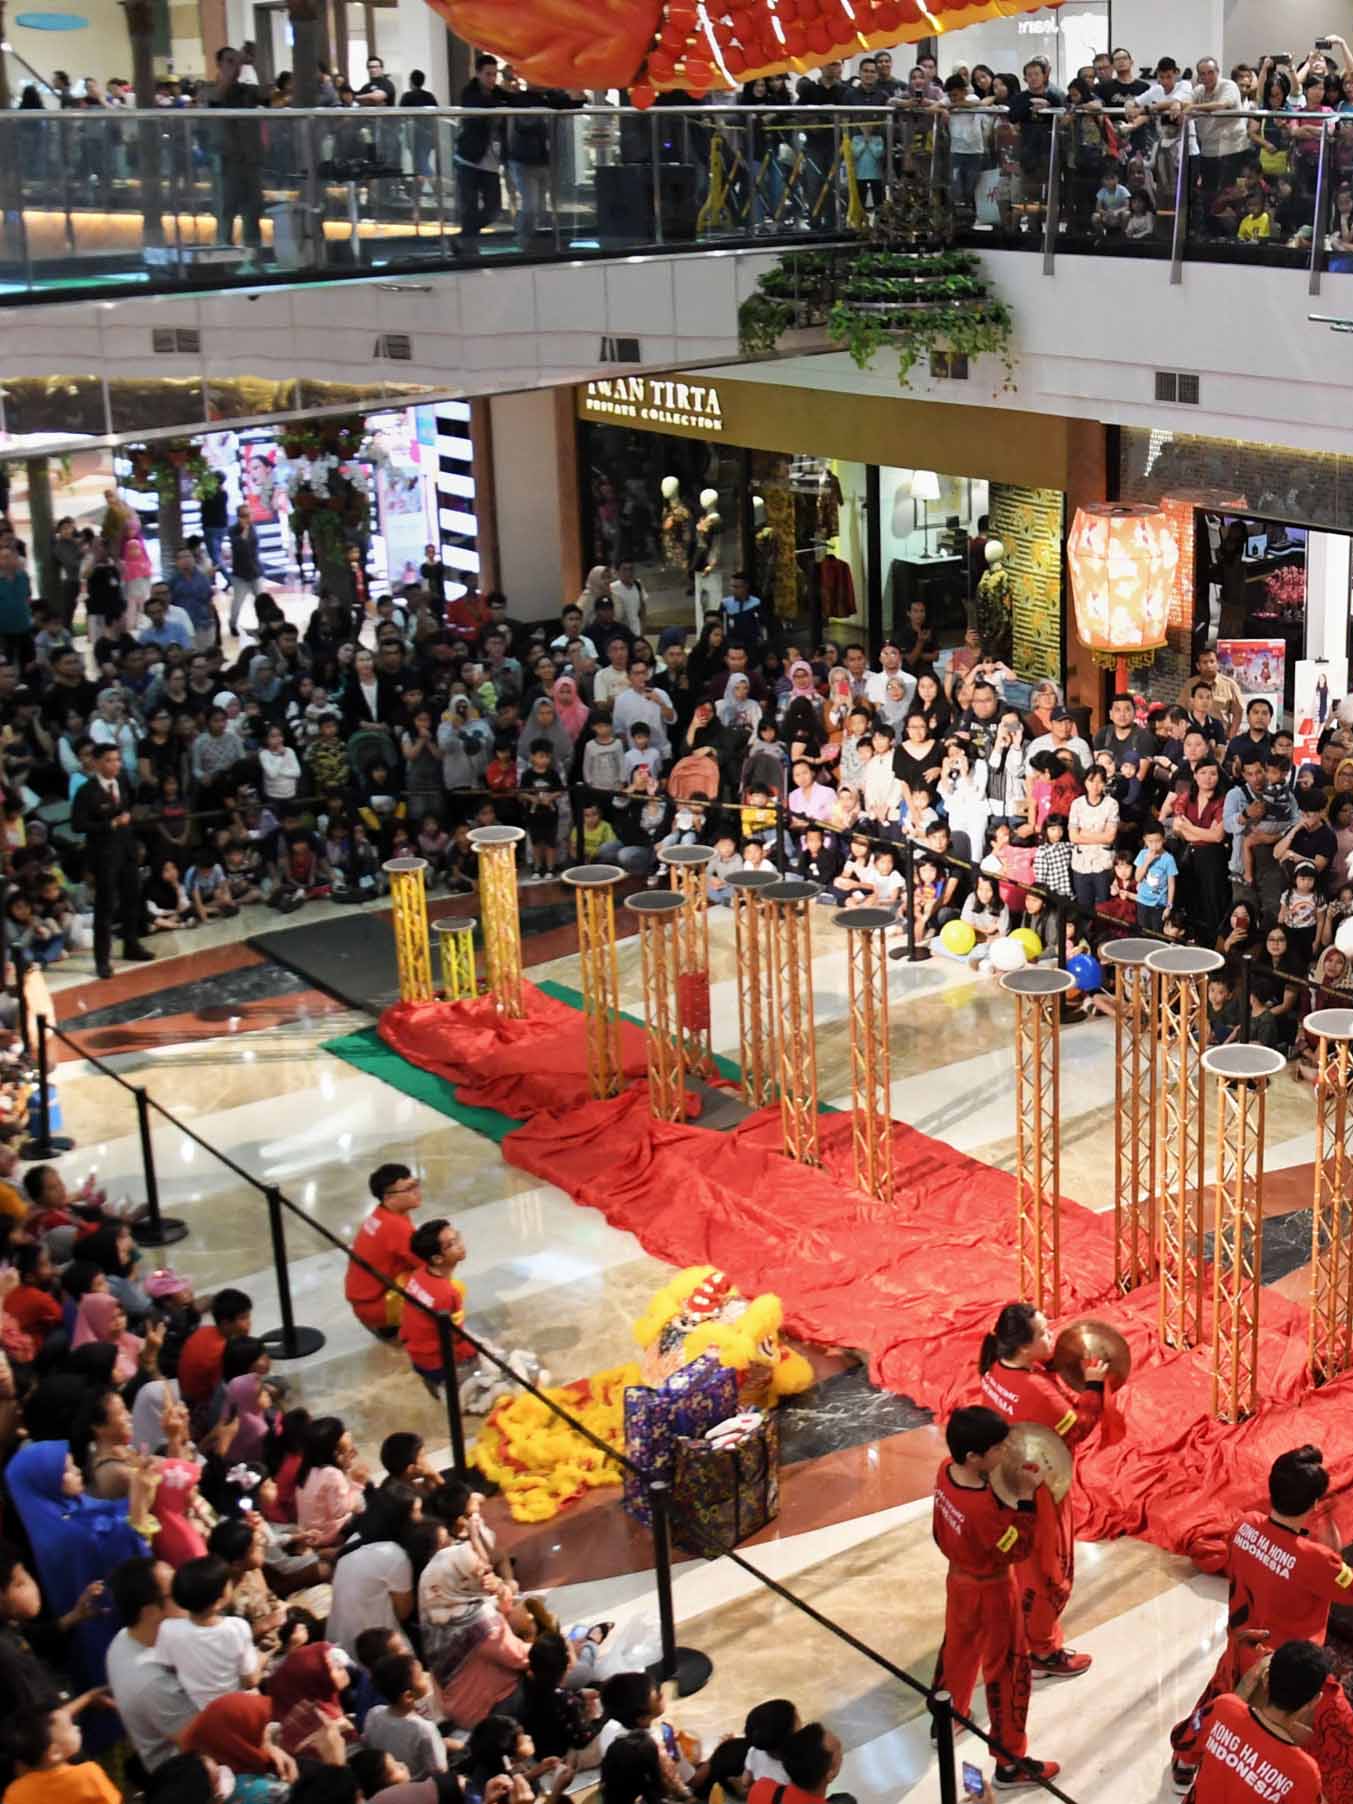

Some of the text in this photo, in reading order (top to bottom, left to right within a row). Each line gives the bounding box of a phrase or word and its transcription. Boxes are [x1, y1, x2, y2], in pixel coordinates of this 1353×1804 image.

[586, 398, 722, 430] PRIVATE COLLECTION
[650, 380, 721, 415] TIRTA
[1233, 1534, 1290, 1579] INDONESIA
[1256, 1534, 1270, 1553] HA
[1268, 1544, 1297, 1570] HONG
[1205, 1736, 1282, 1803] INDONESIA
[1210, 1719, 1294, 1795] KONG HA HONG
